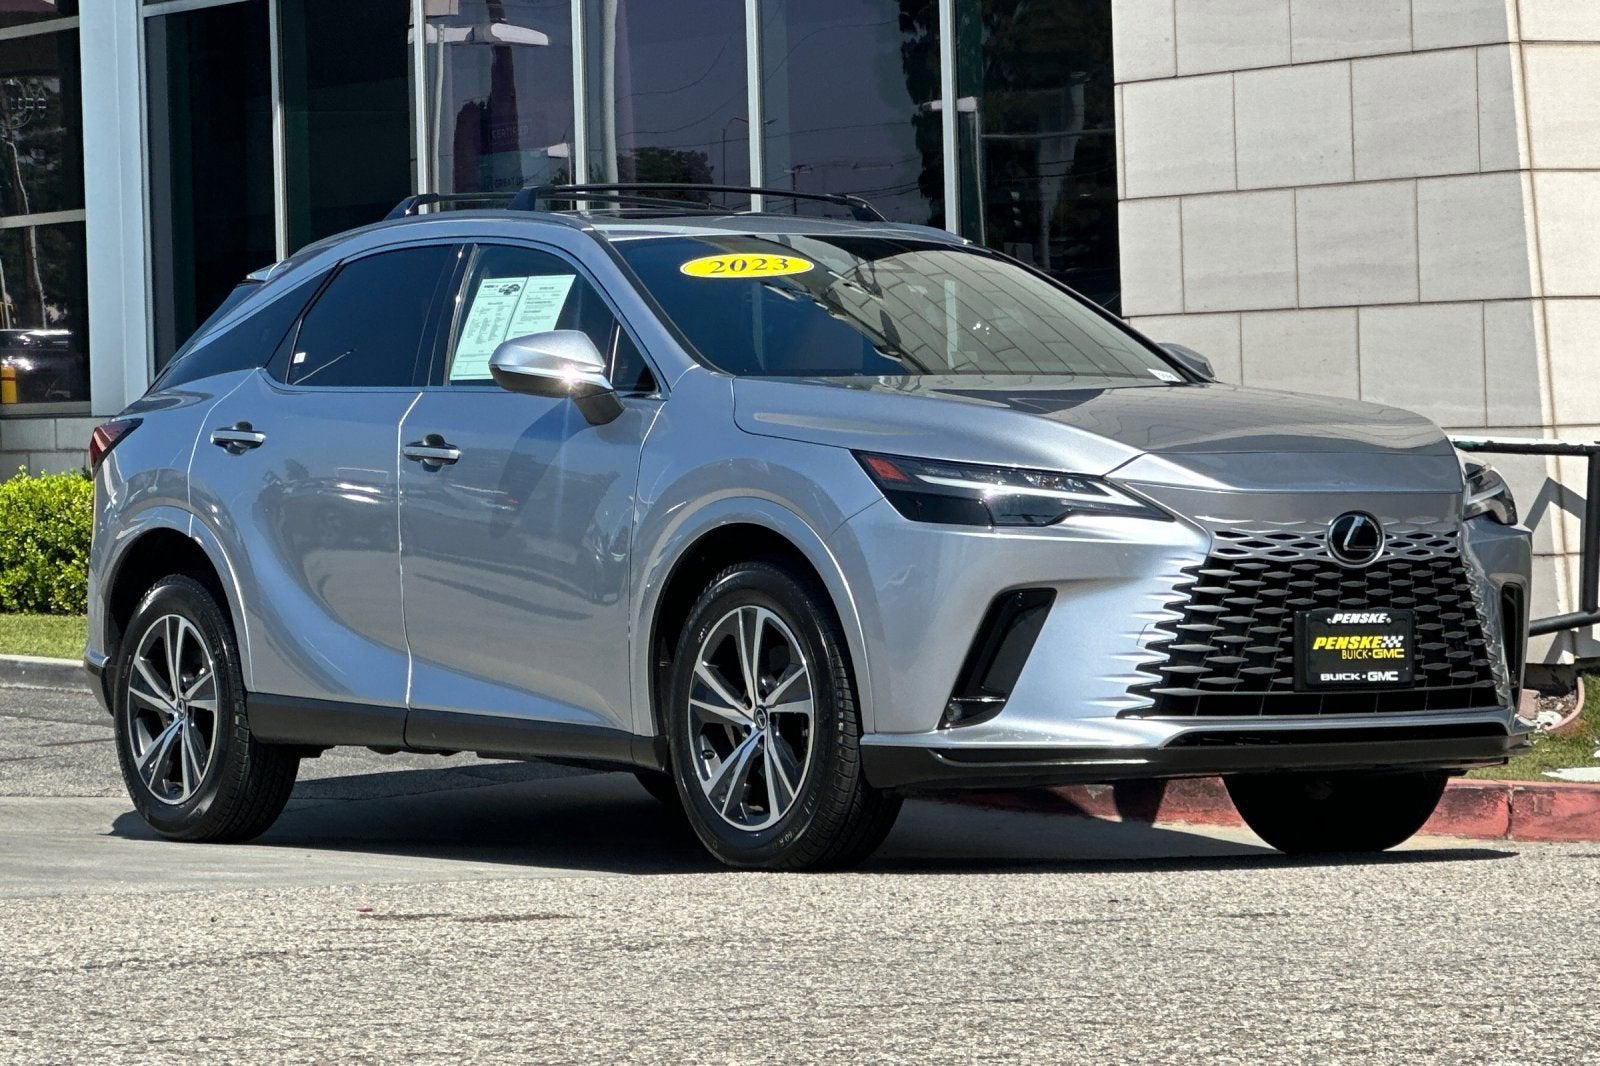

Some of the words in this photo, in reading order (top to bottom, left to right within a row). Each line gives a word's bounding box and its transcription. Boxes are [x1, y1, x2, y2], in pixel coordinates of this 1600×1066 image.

[710, 258, 788, 274] 2023
[1331, 613, 1388, 623] PENSKE
[1313, 636, 1383, 649] PENSKE
[1342, 649, 1367, 659] BUICK
[1372, 649, 1404, 658] GMC
[1320, 673, 1360, 681] BUICK
[1367, 671, 1398, 681] GMC
